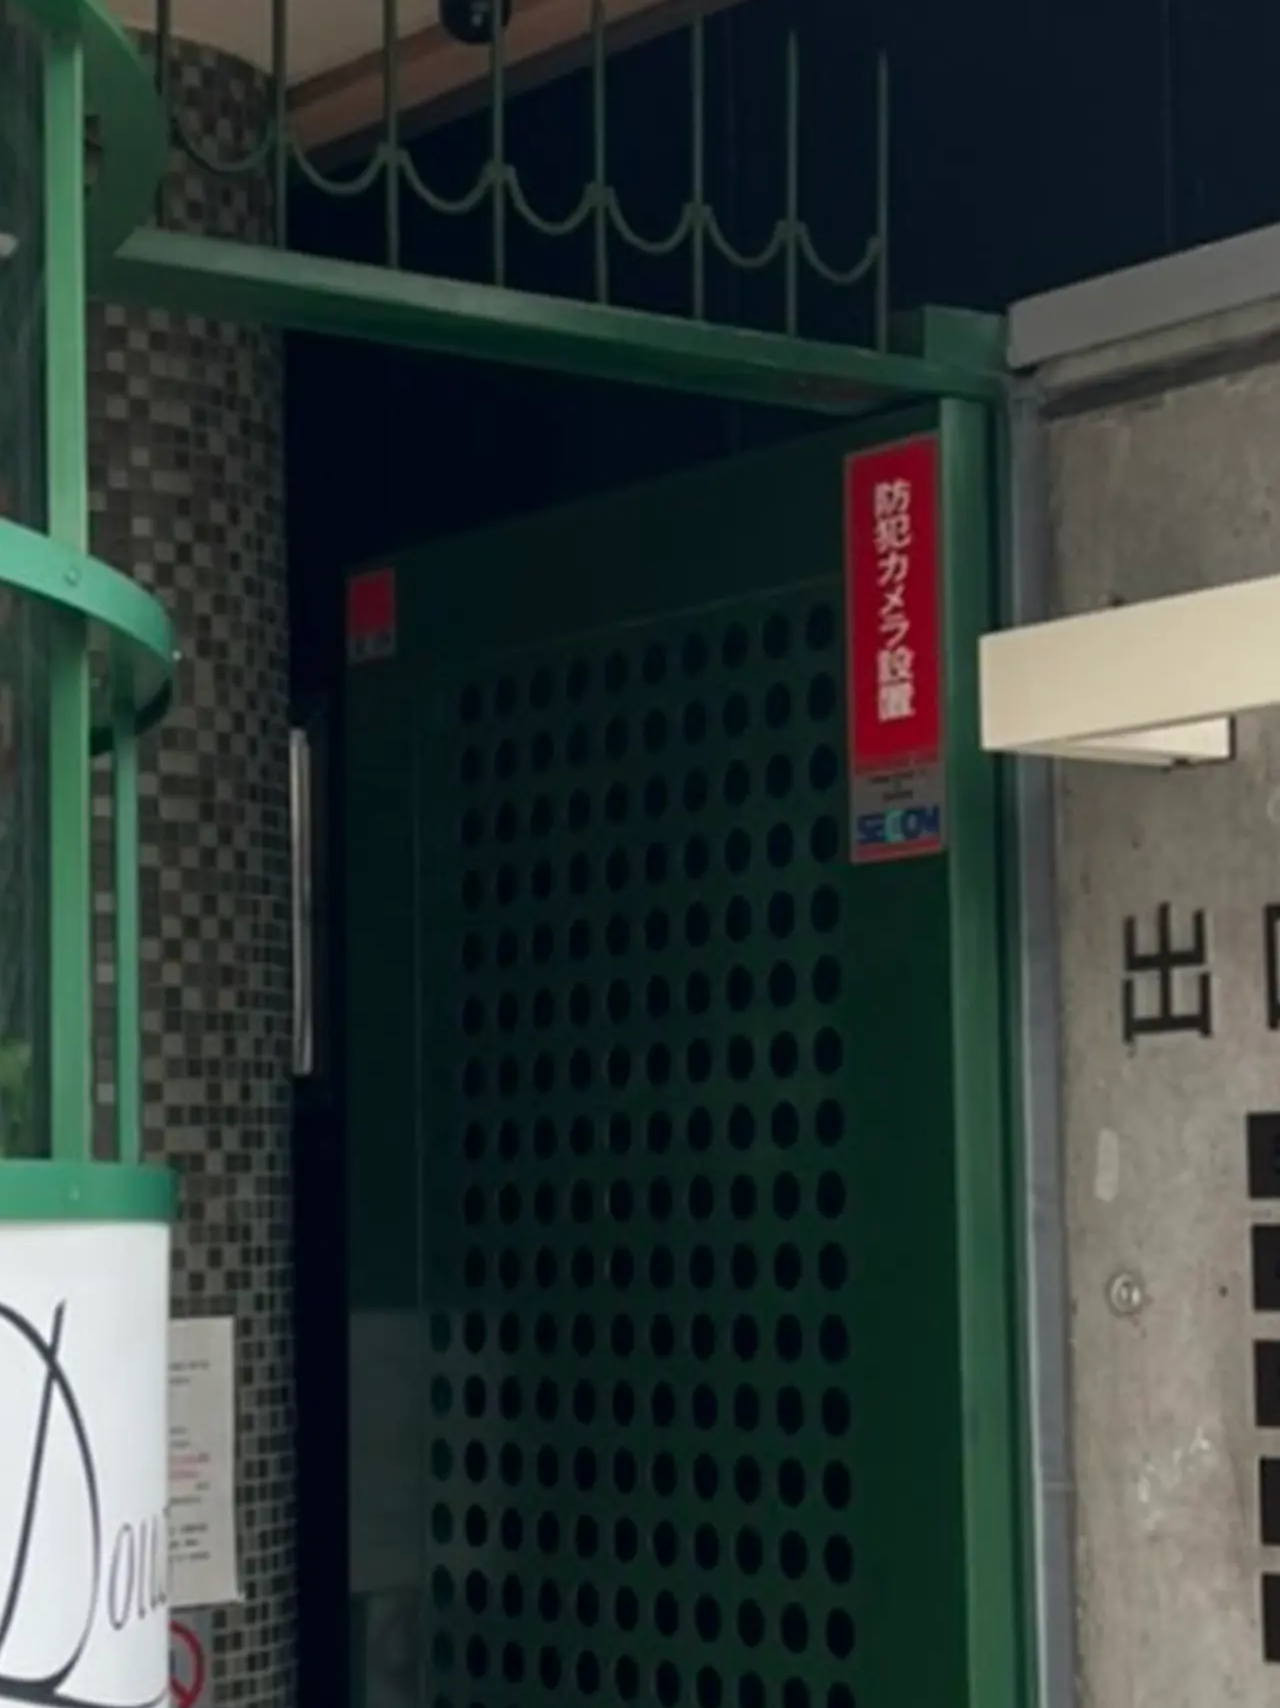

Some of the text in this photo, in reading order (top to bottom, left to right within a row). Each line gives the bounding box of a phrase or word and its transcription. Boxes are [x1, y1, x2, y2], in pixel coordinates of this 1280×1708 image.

[874, 478, 914, 722] 防犯カメラ設置
